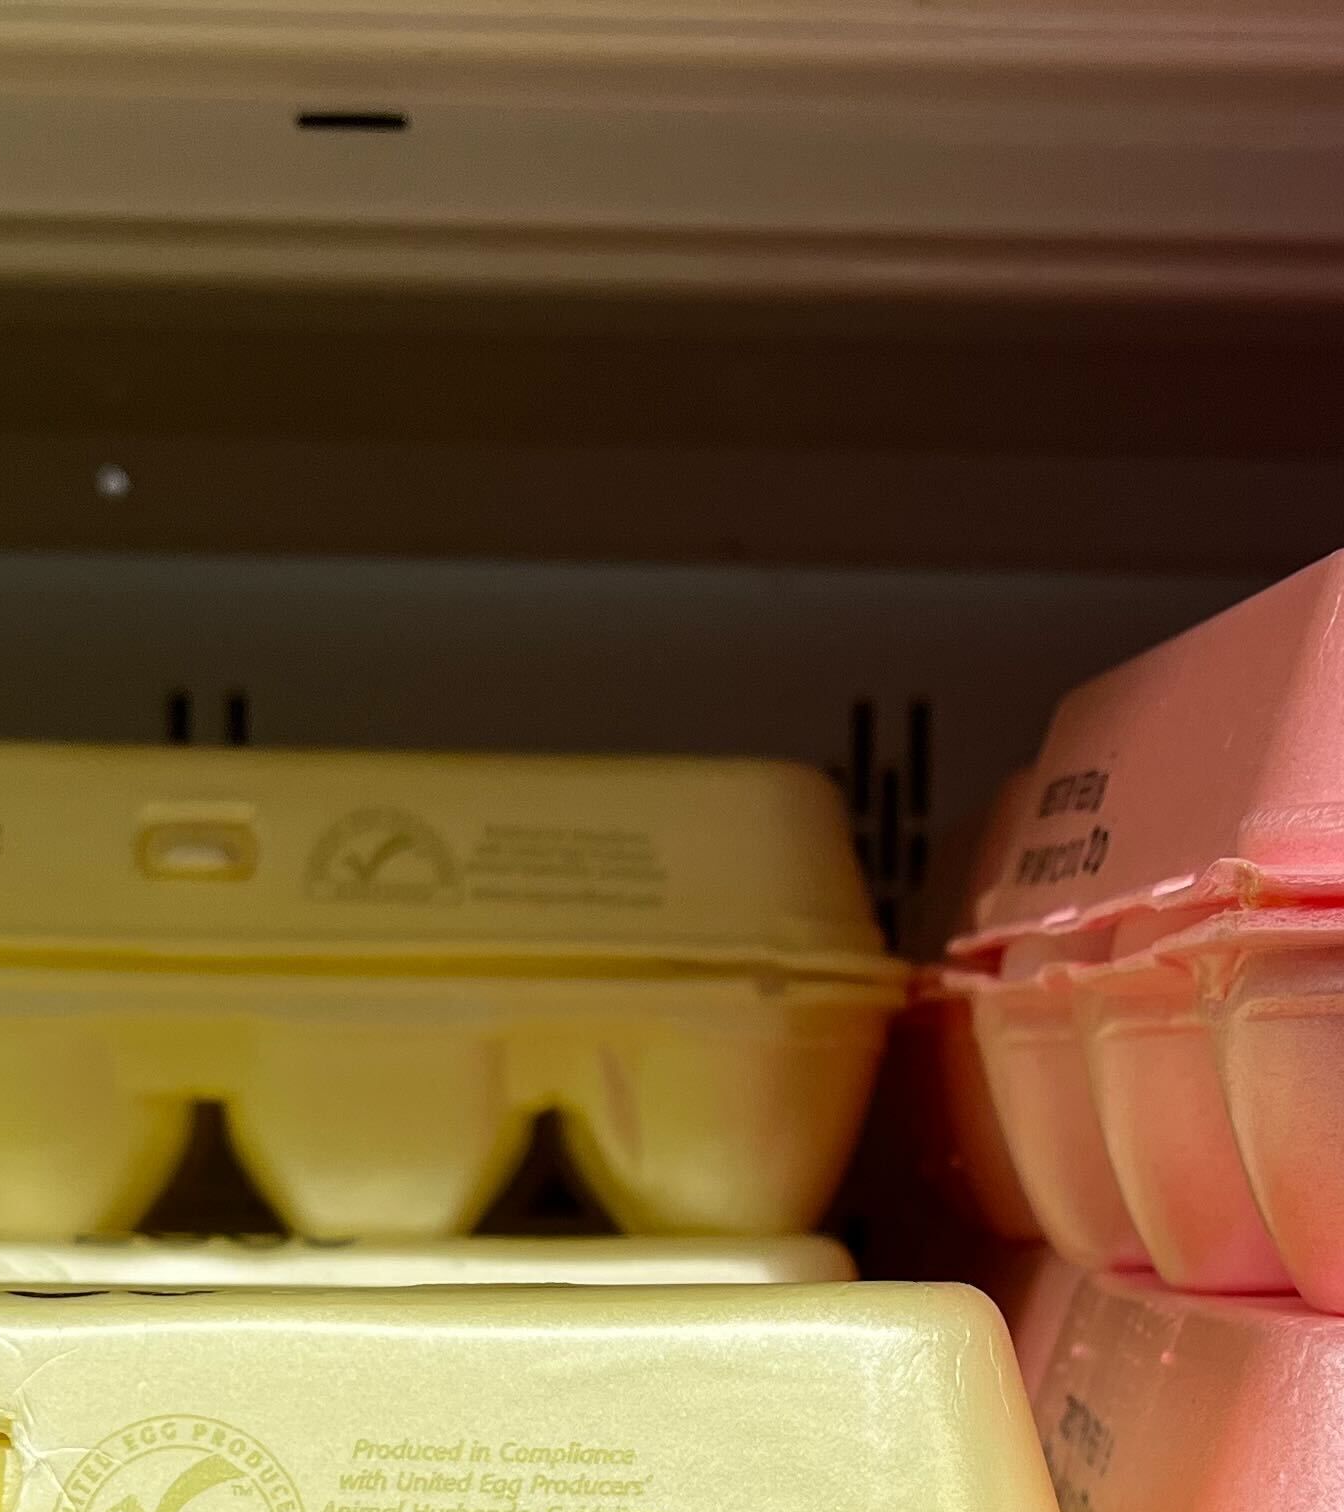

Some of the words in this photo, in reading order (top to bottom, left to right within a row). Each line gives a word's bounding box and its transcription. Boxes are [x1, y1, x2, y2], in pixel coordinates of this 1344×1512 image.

[122, 1421, 177, 1451] EGG
[352, 1438, 466, 1462] Produced
[469, 1440, 491, 1461] in
[499, 1441, 637, 1468] Compliance
[339, 1469, 387, 1492] with
[397, 1471, 475, 1494] United
[479, 1474, 523, 1500] Egg
